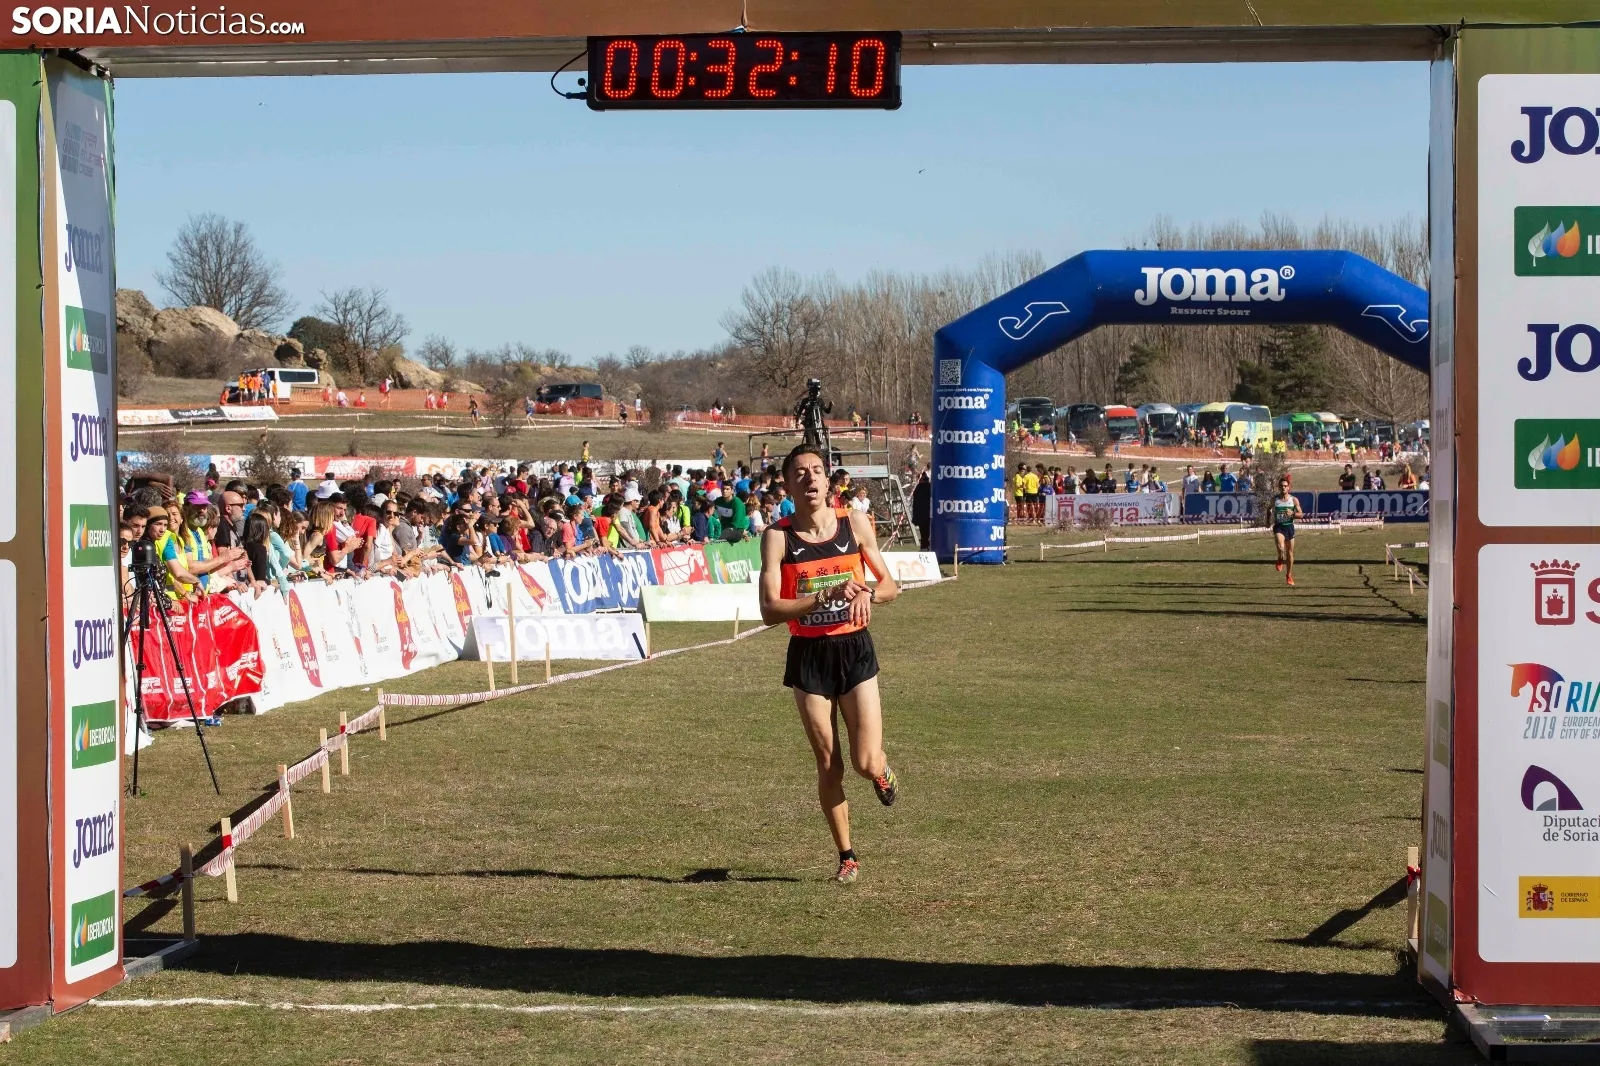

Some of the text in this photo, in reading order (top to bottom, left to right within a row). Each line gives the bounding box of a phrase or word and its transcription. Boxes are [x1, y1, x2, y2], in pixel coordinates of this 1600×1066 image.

[603, 39, 886, 98] 00:32:10
[1523, 716, 1557, 739] 2019
[1562, 716, 1600, 727] EUROPEA
[1560, 728, 1579, 739] CITY
[1580, 728, 1590, 739] OF
[1543, 828, 1599, 842] de Soria
